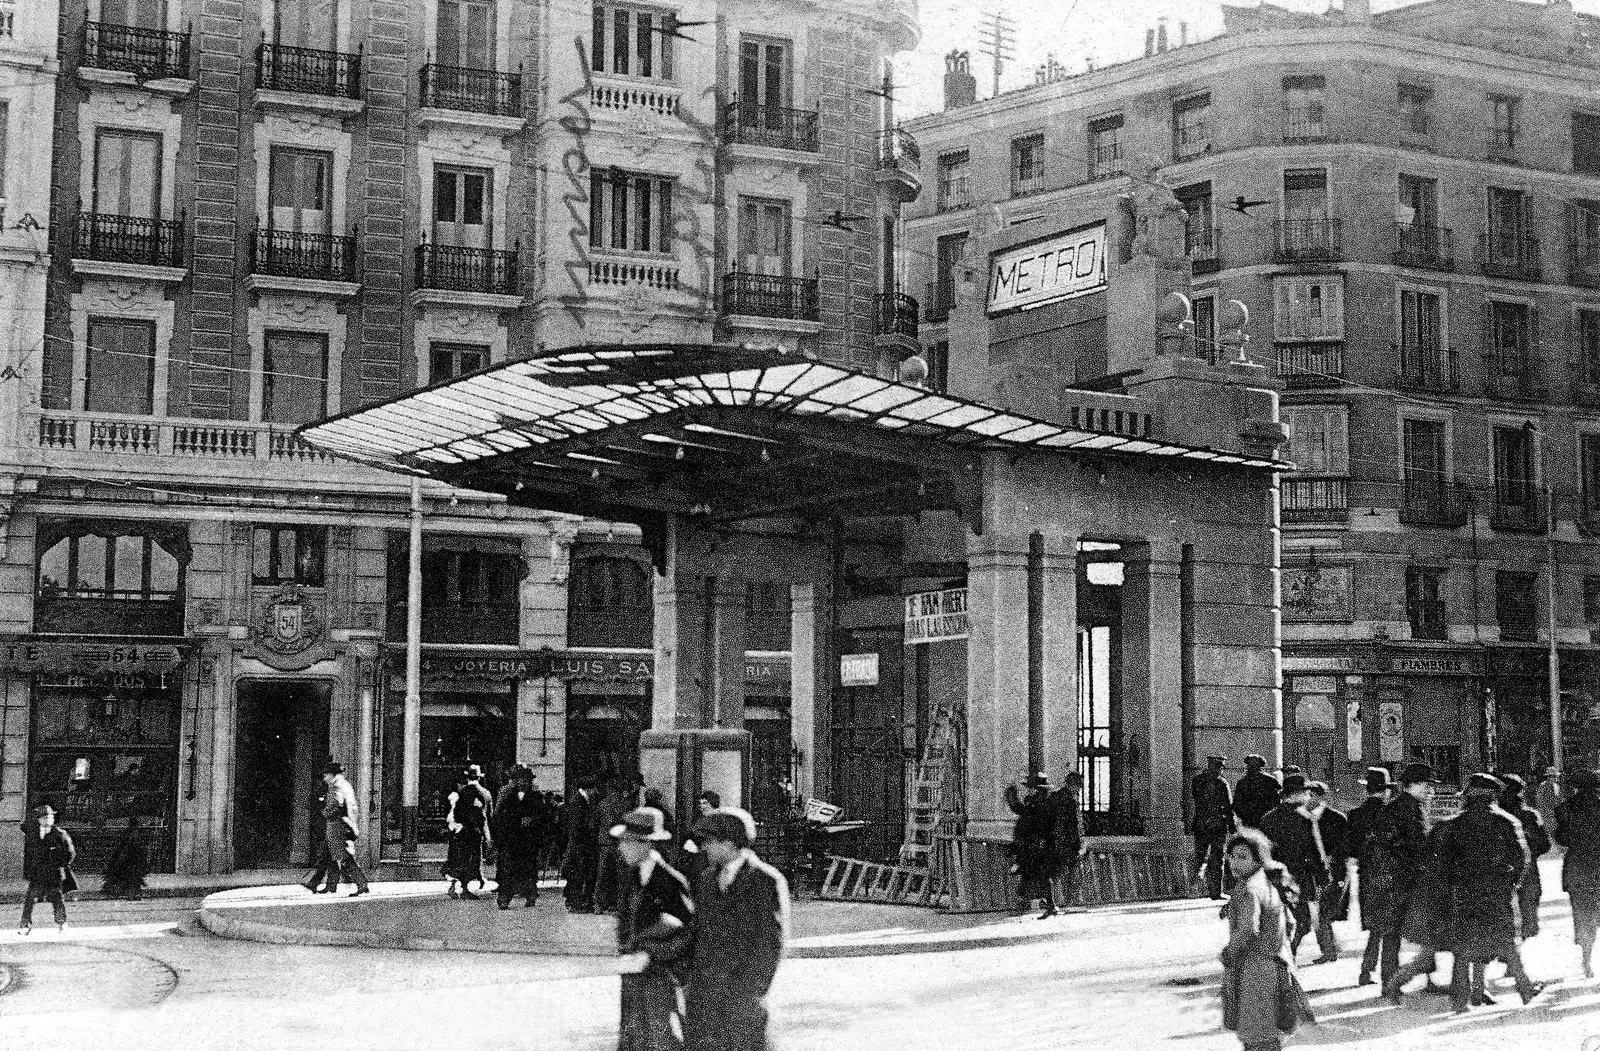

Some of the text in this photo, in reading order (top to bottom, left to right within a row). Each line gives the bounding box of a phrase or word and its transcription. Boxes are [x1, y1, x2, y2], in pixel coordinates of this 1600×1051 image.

[994, 239, 1096, 300] METRO
[281, 616, 296, 631] 54
[112, 648, 140, 663] 54
[453, 660, 528, 672] JOYERIA
[550, 660, 604, 674] LUIS
[745, 666, 772, 676] RIA
[1401, 660, 1462, 671] FIAMBRES
